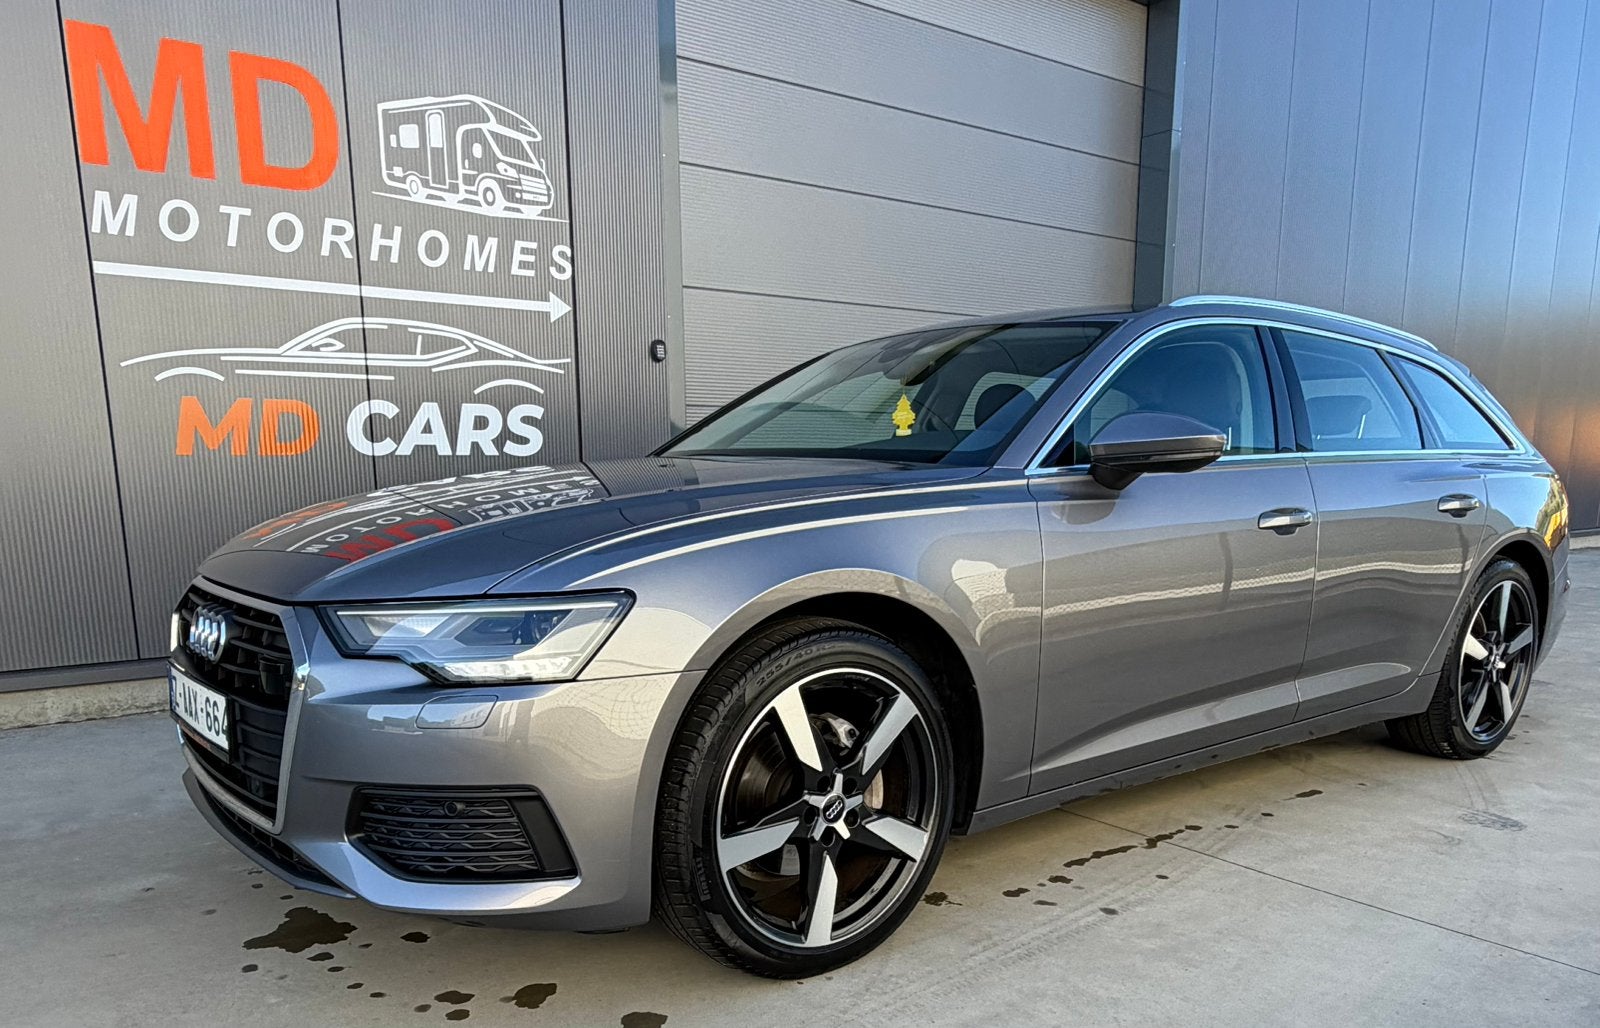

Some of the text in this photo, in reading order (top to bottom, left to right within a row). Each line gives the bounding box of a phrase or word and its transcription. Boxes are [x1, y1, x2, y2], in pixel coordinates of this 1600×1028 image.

[64, 19, 339, 191] MD
[91, 190, 573, 281] MOTORHOMES
[175, 395, 545, 457] MD CARS
